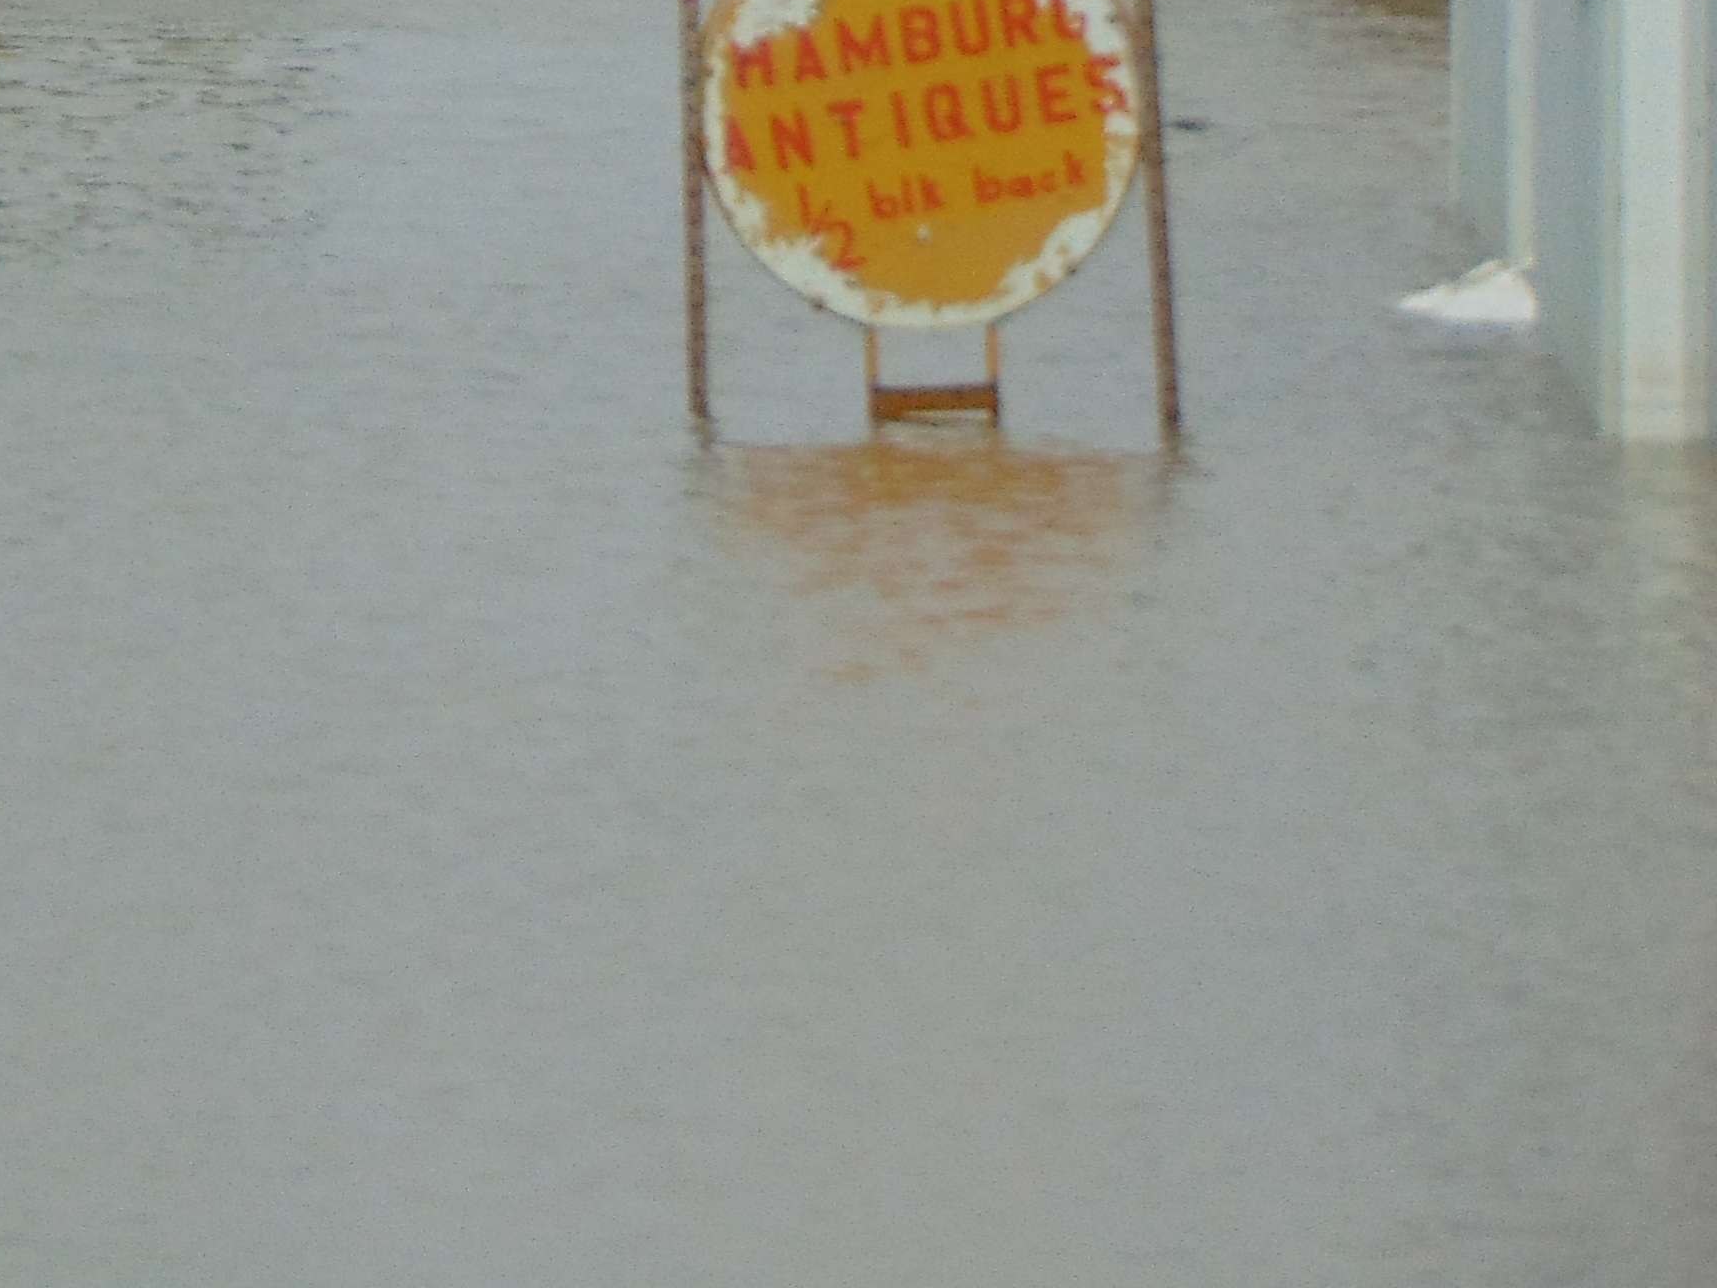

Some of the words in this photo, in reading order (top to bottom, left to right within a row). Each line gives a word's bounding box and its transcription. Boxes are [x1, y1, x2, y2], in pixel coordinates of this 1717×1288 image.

[725, 54, 1128, 175] ANTIQUES
[866, 173, 944, 220] blk
[972, 149, 1087, 206] back
